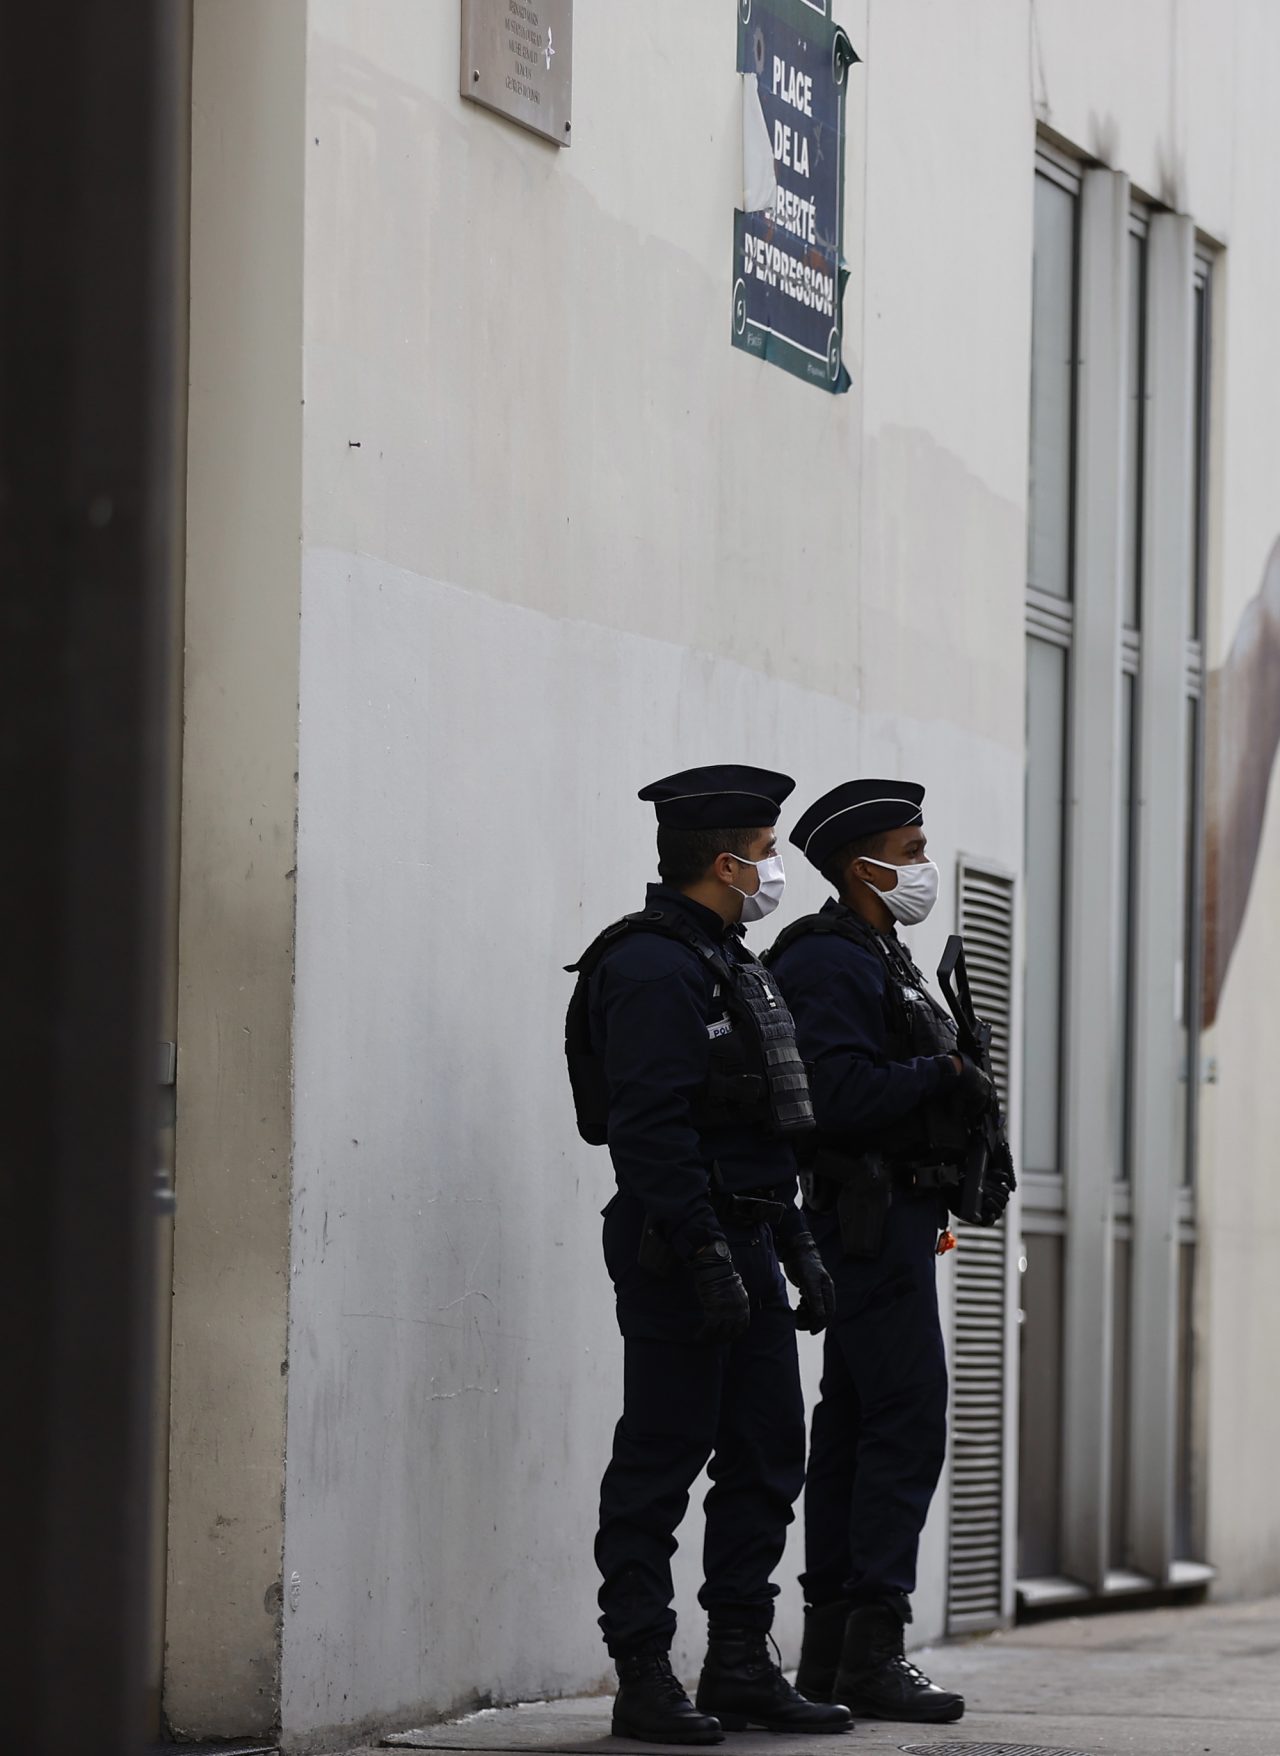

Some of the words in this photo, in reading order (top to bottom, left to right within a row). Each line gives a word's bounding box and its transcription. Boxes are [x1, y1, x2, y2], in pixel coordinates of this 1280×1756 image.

[772, 55, 812, 118] PLACE
[774, 119, 791, 167] DE
[793, 131, 810, 178] LA
[764, 184, 816, 246] BERTÉ
[744, 232, 834, 318] D'EXPRESSION
